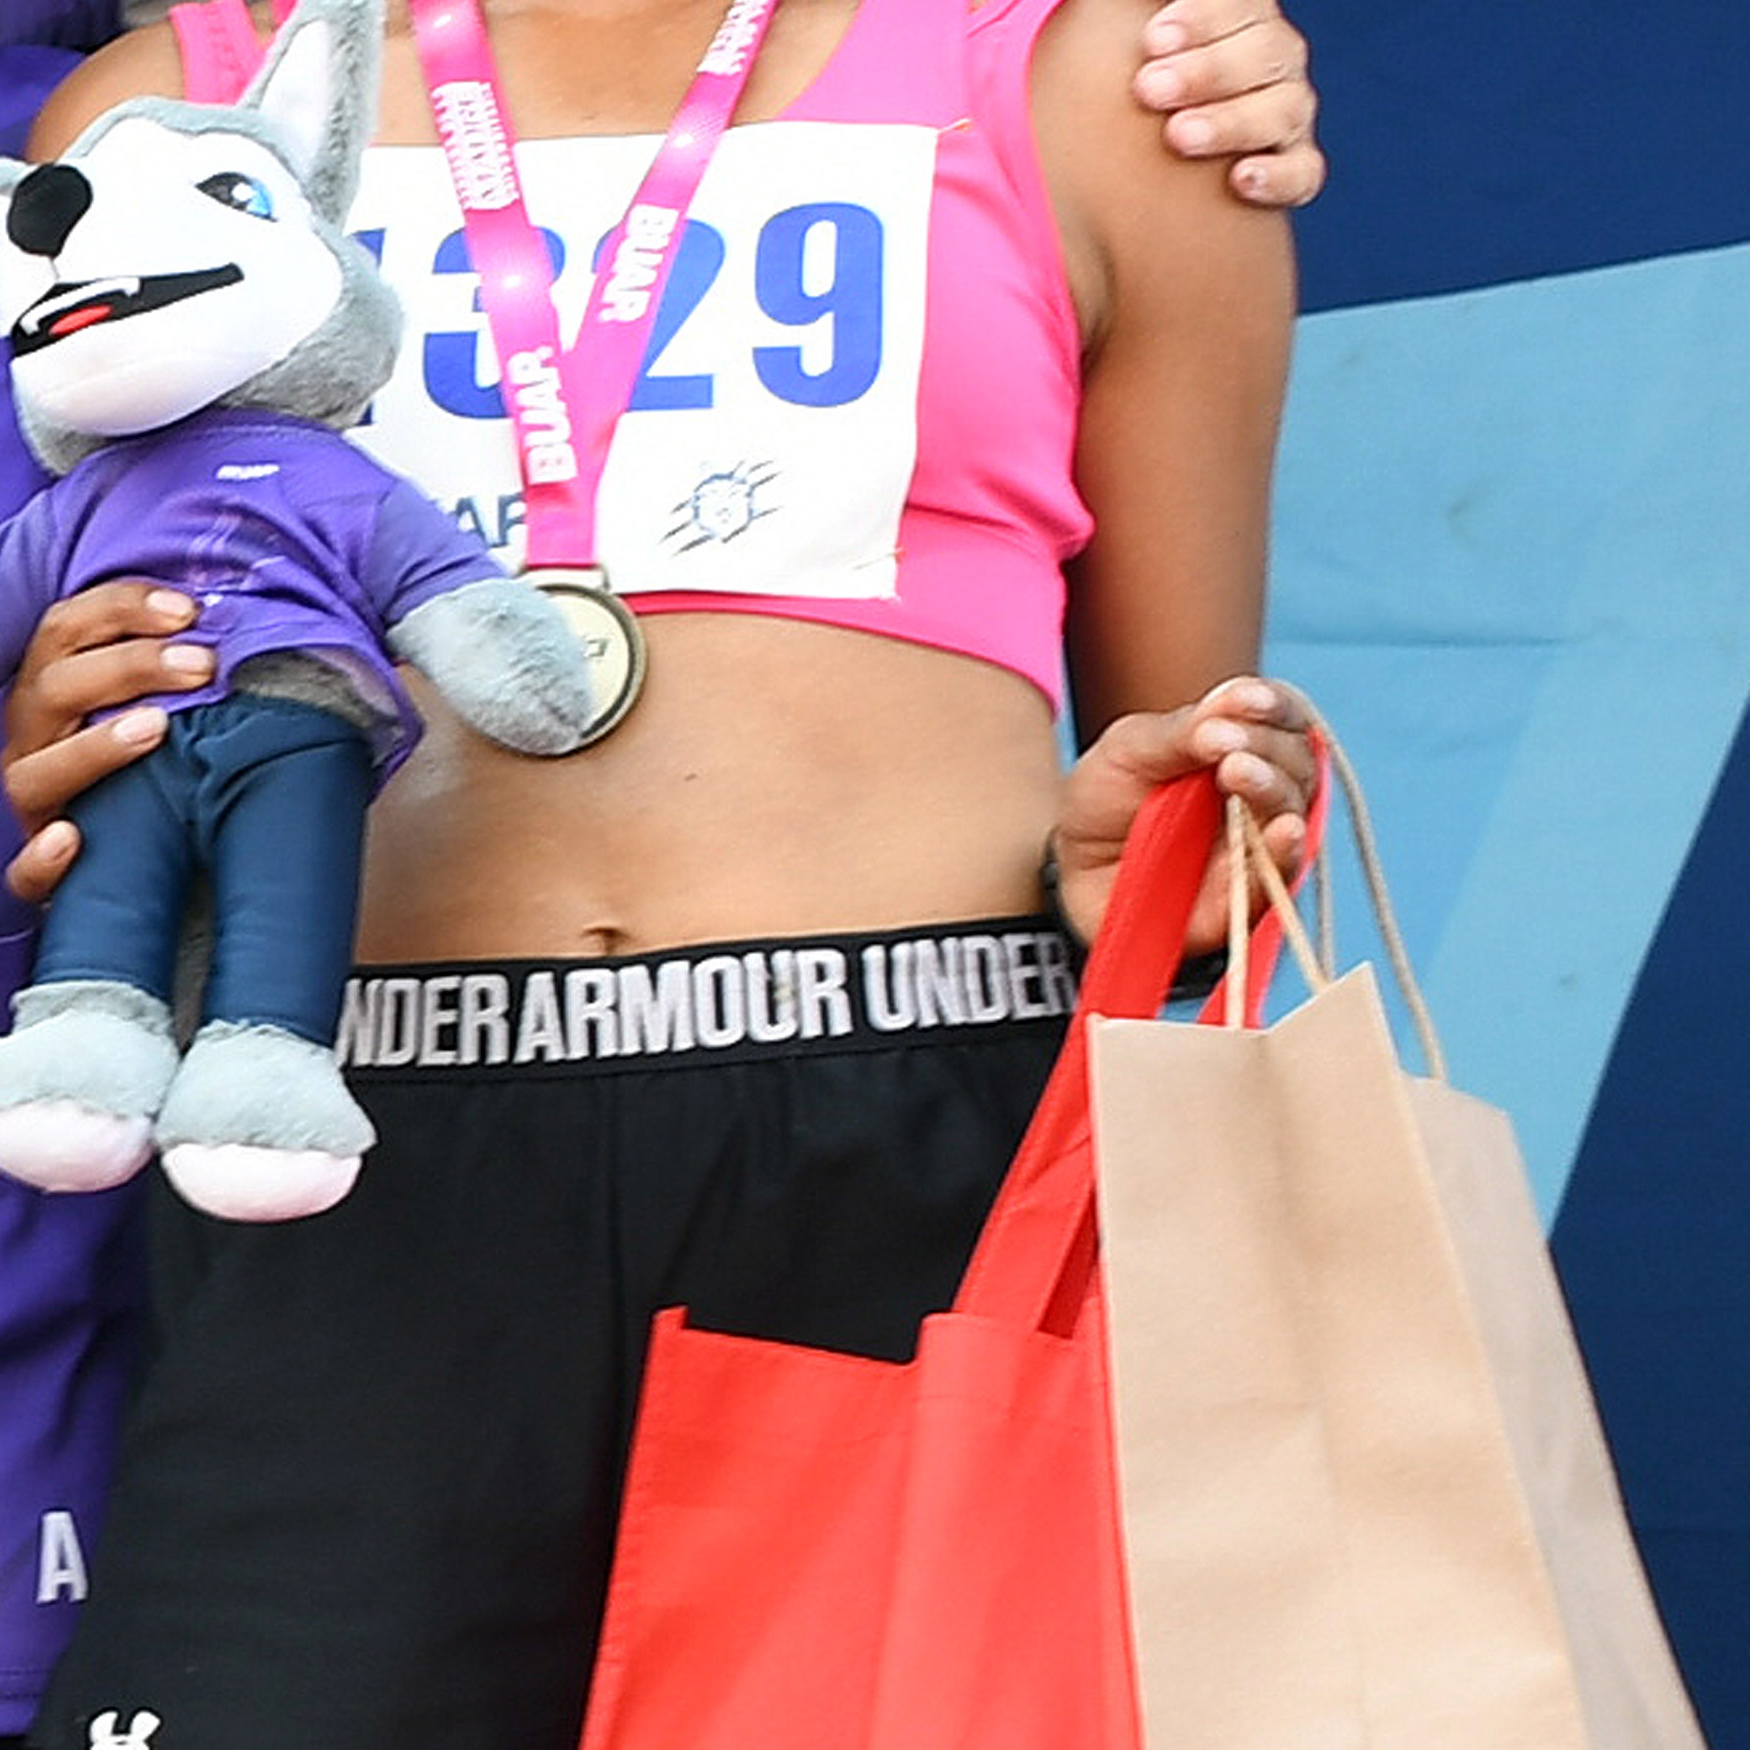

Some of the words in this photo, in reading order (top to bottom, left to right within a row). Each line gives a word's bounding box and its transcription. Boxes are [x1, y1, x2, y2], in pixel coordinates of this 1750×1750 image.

[348, 202, 884, 426] 329
[598, 204, 680, 323] BUAP
[506, 346, 578, 486] BUAP
[513, 948, 853, 1064] ARMOUR
[861, 931, 1078, 1033] UNDER
